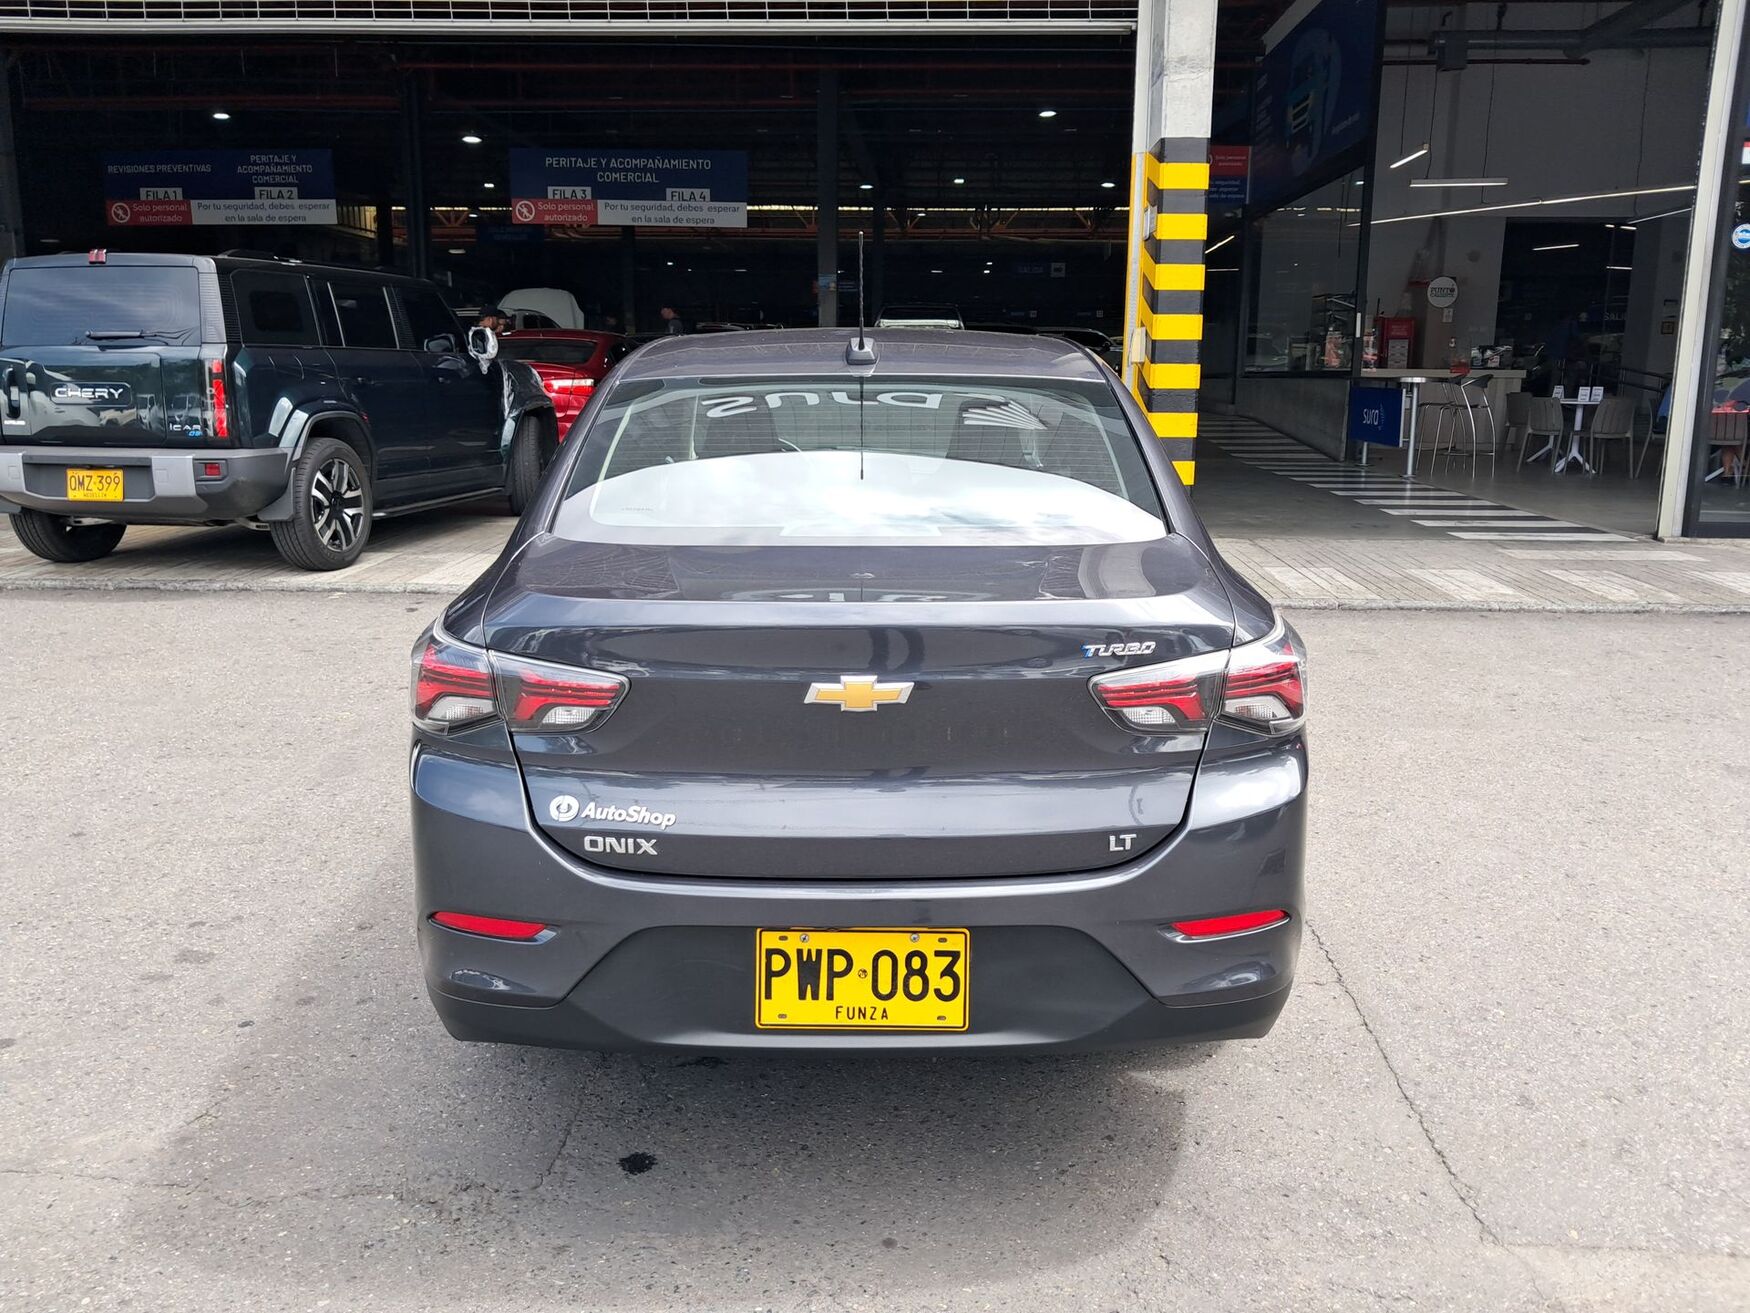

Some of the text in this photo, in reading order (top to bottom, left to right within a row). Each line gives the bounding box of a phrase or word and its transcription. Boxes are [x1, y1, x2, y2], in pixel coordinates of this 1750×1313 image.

[250, 155, 297, 163] PERITAJE Y
[546, 156, 712, 170] PERITAJE Y ACOMPAÑAMIENTO
[108, 164, 212, 174] REVISIONES PREVENTIVAS
[237, 164, 313, 173] ACOMPAÑAMIENTO
[252, 175, 299, 184] COMERCIAL
[597, 172, 660, 183] COMERCIAL
[146, 190, 173, 200] FILA
[259, 190, 294, 199] FILA 2
[552, 190, 587, 199] FILA 3
[671, 191, 706, 201] FILA 4
[133, 203, 187, 213] Solo personal
[198, 202, 212, 210] Por
[298, 203, 330, 212] esperar
[538, 202, 594, 212] Solo personal
[604, 203, 618, 211] Por
[620, 203, 629, 211] tu
[677, 204, 704, 212] debes
[707, 205, 740, 214] esperar
[139, 214, 183, 222] autorizado
[278, 215, 306, 223] espera
[544, 214, 588, 222] autorizado
[645, 215, 653, 223] la
[657, 216, 675, 224] sala
[676, 216, 684, 224] de
[54, 387, 124, 399] CHERY
[1362, 408, 1380, 426] sura
[96, 475, 121, 492] 399
[1080, 641, 1156, 658] TURBO
[580, 801, 676, 830] AutoShop
[583, 835, 658, 856] ONIX
[1109, 833, 1137, 851] LT
[764, 948, 961, 1002] PWP 083
[835, 1006, 889, 1020] FUNZA
